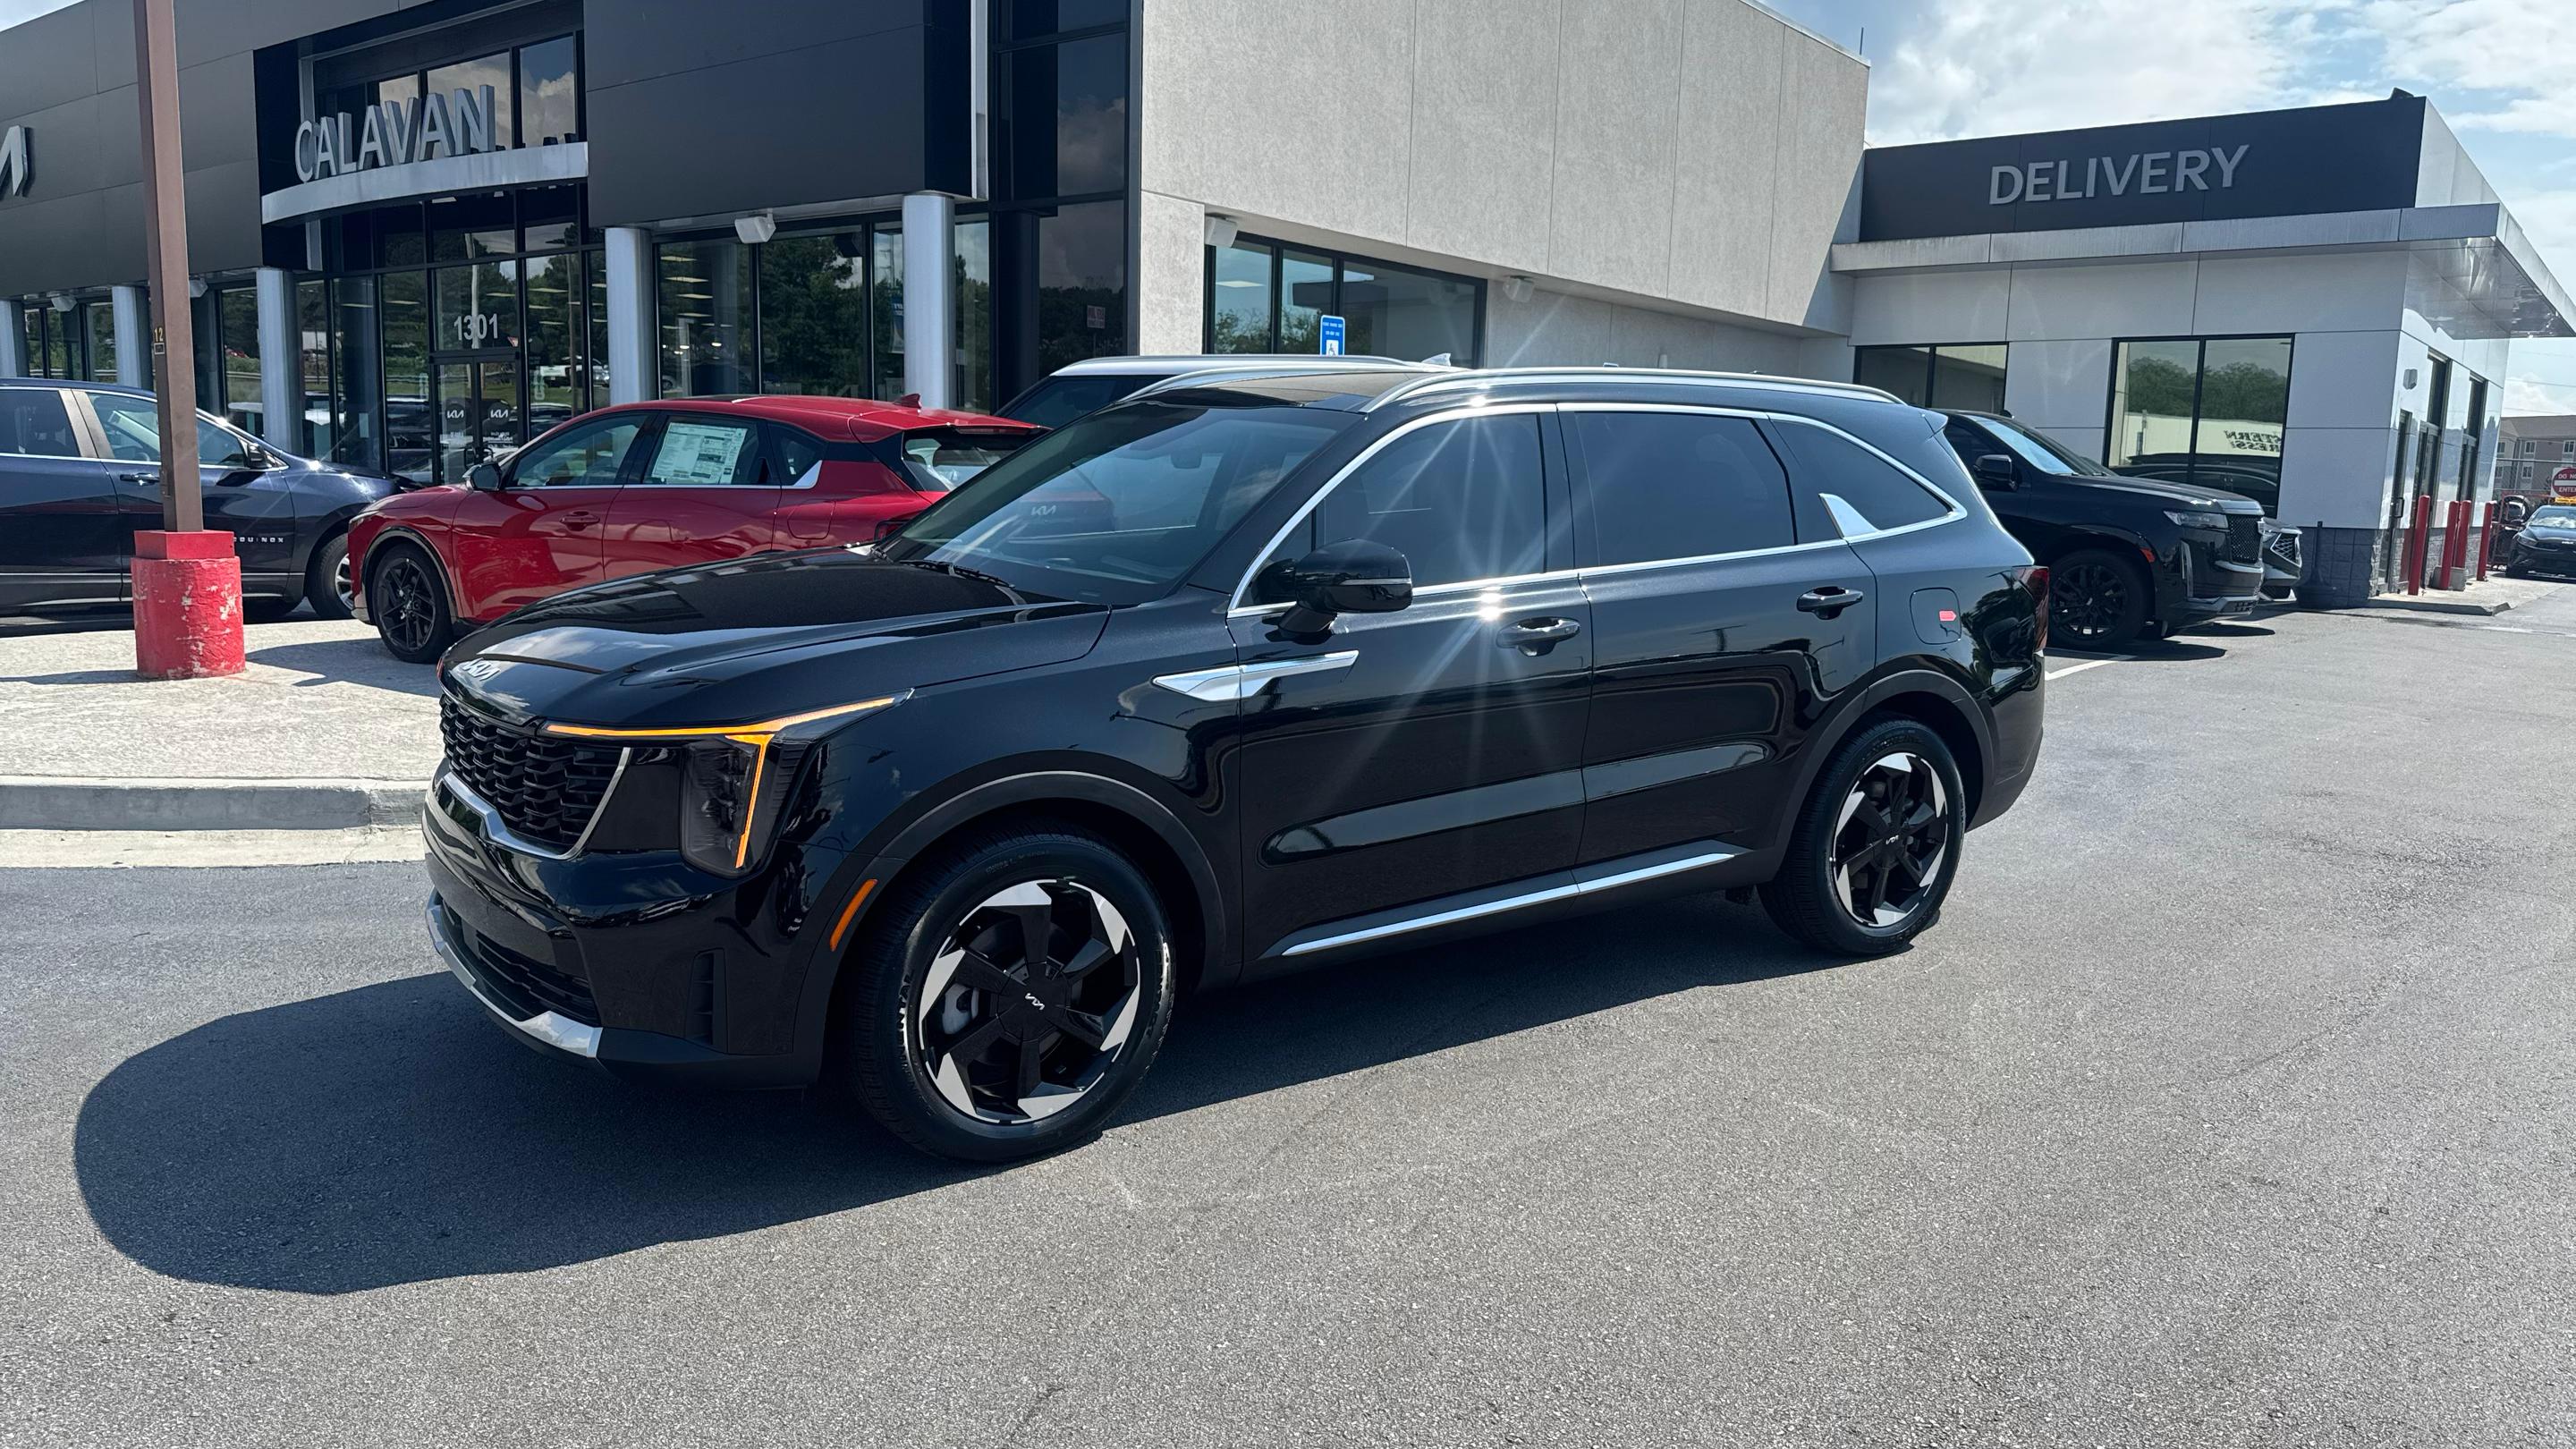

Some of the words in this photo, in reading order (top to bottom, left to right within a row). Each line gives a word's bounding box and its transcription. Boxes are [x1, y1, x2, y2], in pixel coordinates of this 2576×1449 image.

[295, 84, 495, 182] CALAVAN
[1989, 144, 2250, 205] DELIVERY
[154, 327, 164, 342] 12
[453, 314, 498, 341] 1301
